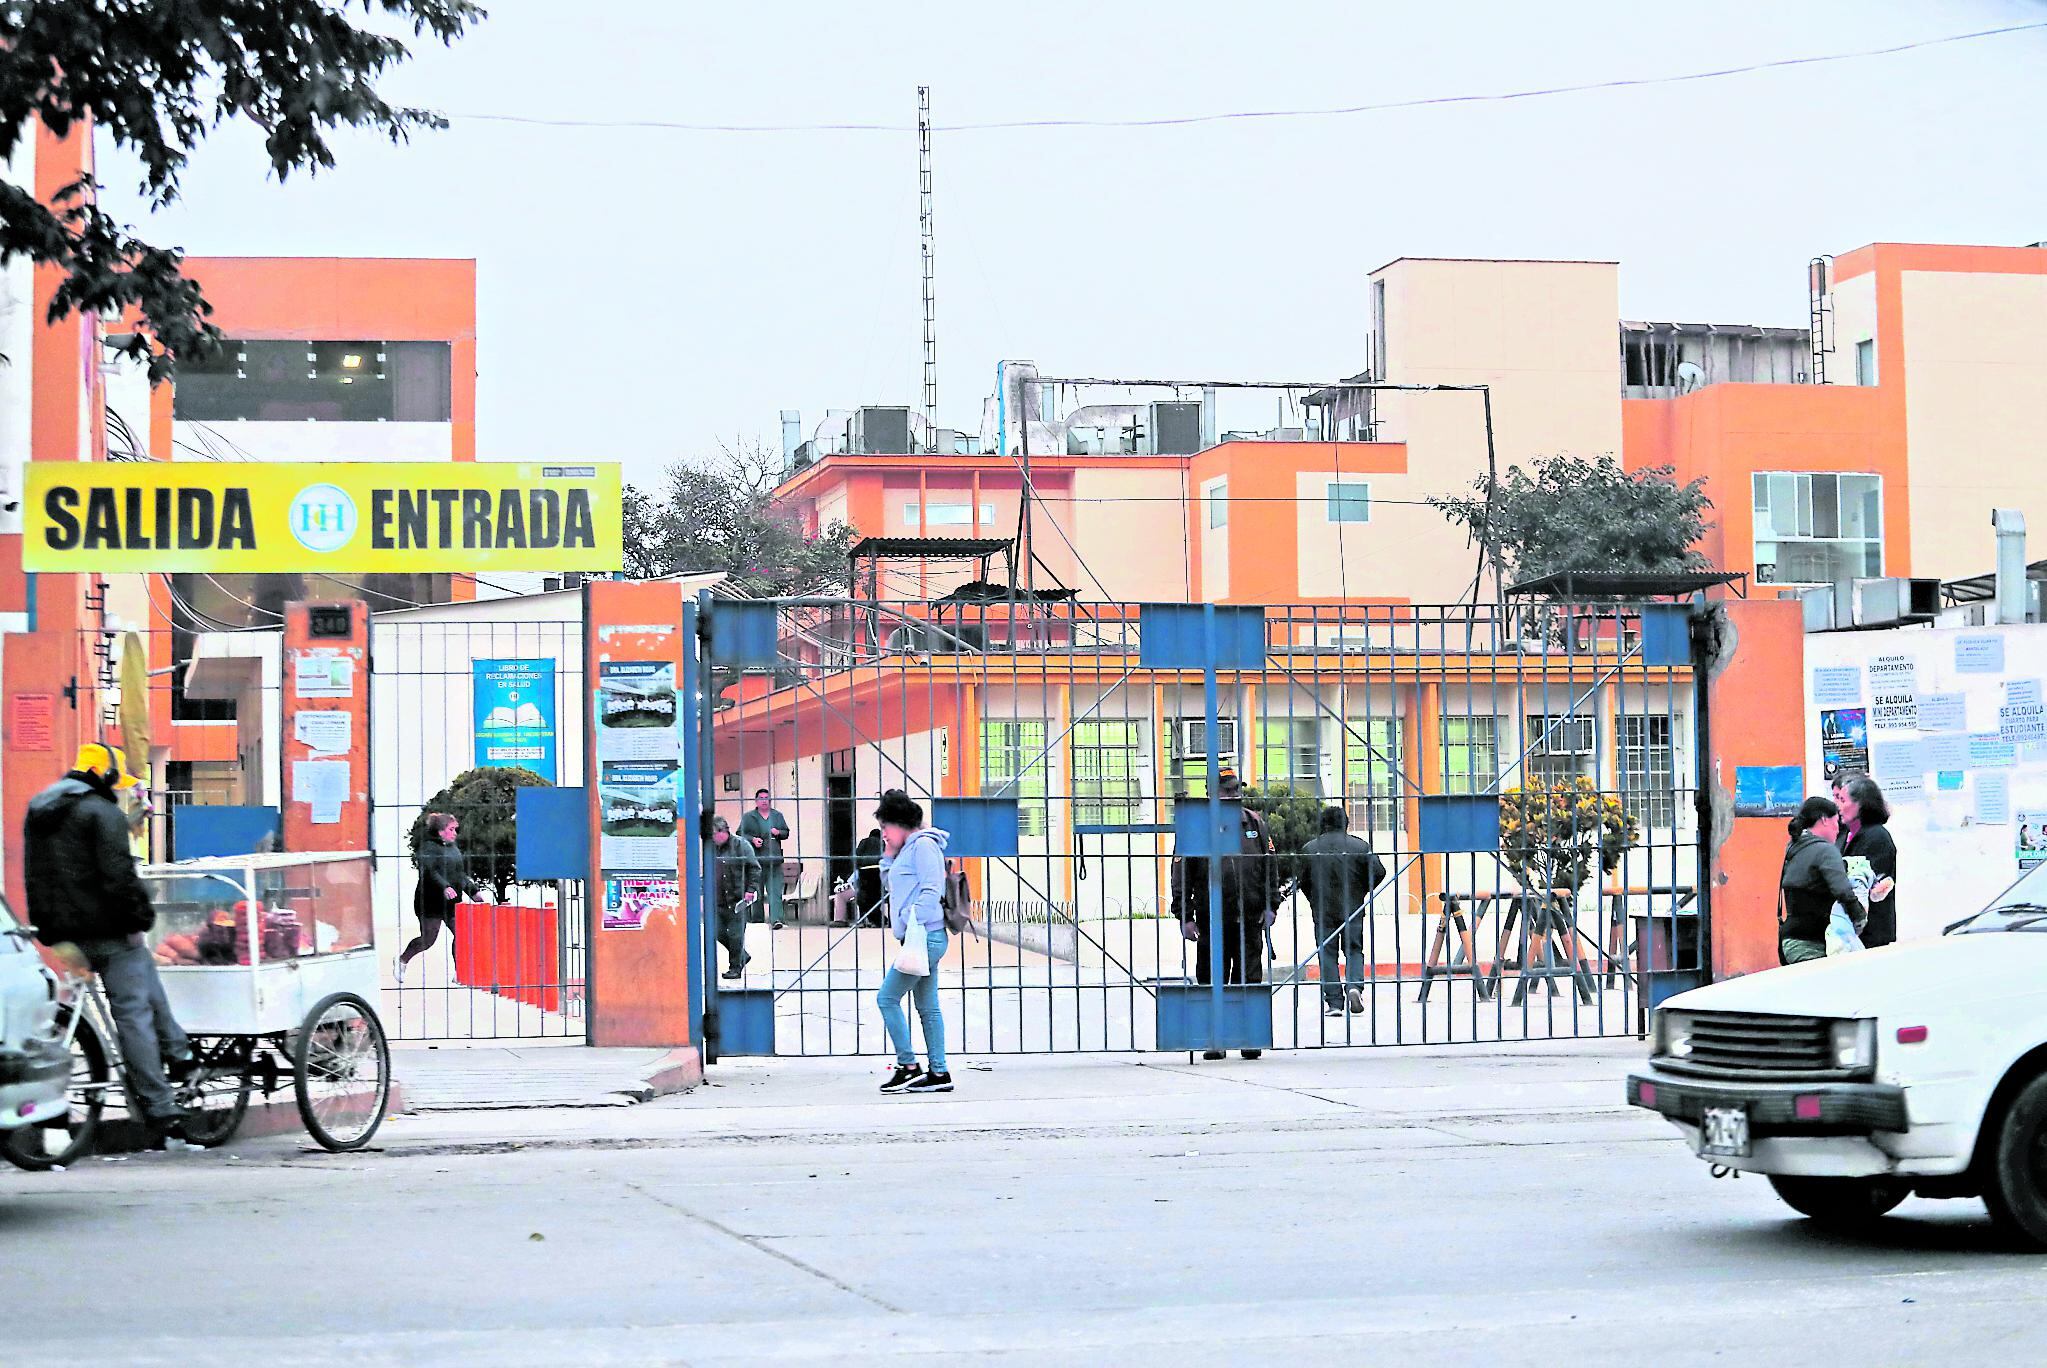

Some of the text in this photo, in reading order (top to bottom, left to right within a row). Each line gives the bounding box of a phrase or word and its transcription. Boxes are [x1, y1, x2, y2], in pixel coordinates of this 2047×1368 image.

[45, 486, 257, 550] SALIDA
[371, 489, 596, 549] ENTRADA
[498, 664, 519, 672] LIBRO
[1869, 663, 1914, 672] DEPARTAMENTO
[1875, 694, 1913, 705] SE ALQUILA
[1883, 705, 1917, 717] DEPARTAMENTO
[2000, 705, 2044, 717] SE ALQUILA
[2000, 723, 2044, 734] ESTUDIANTE
